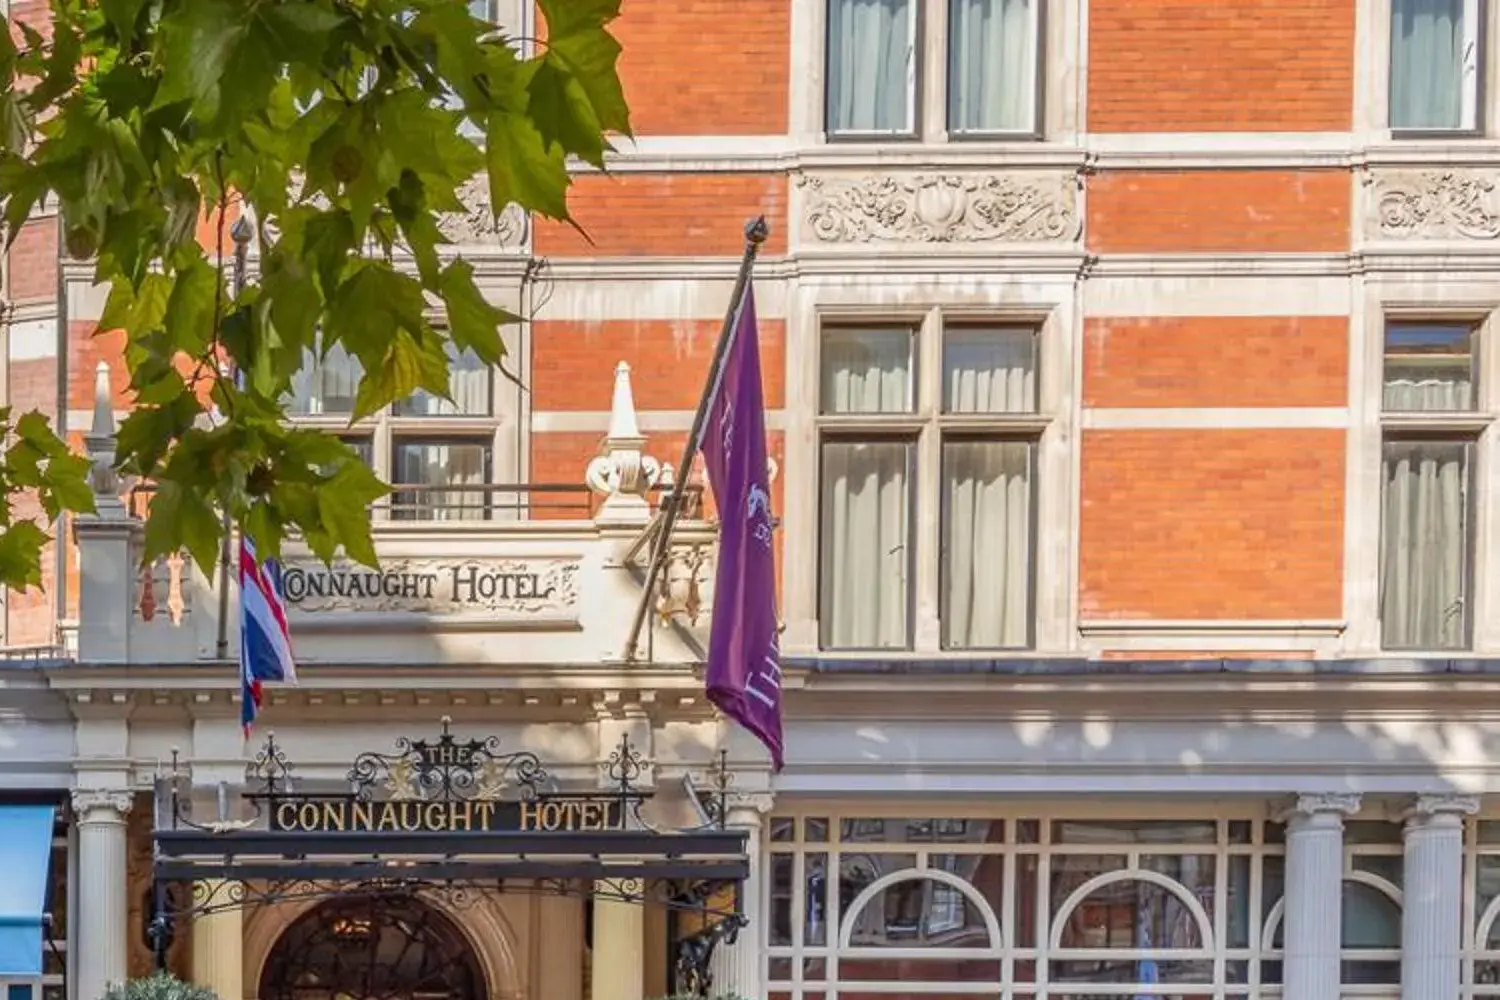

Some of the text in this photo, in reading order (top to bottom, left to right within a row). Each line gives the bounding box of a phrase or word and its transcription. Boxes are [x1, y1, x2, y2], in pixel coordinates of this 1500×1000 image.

[283, 566, 552, 602] CONNAUGHT HOTEL
[425, 747, 470, 764] THE
[276, 802, 624, 832] CONNAUGHT HOTEL
